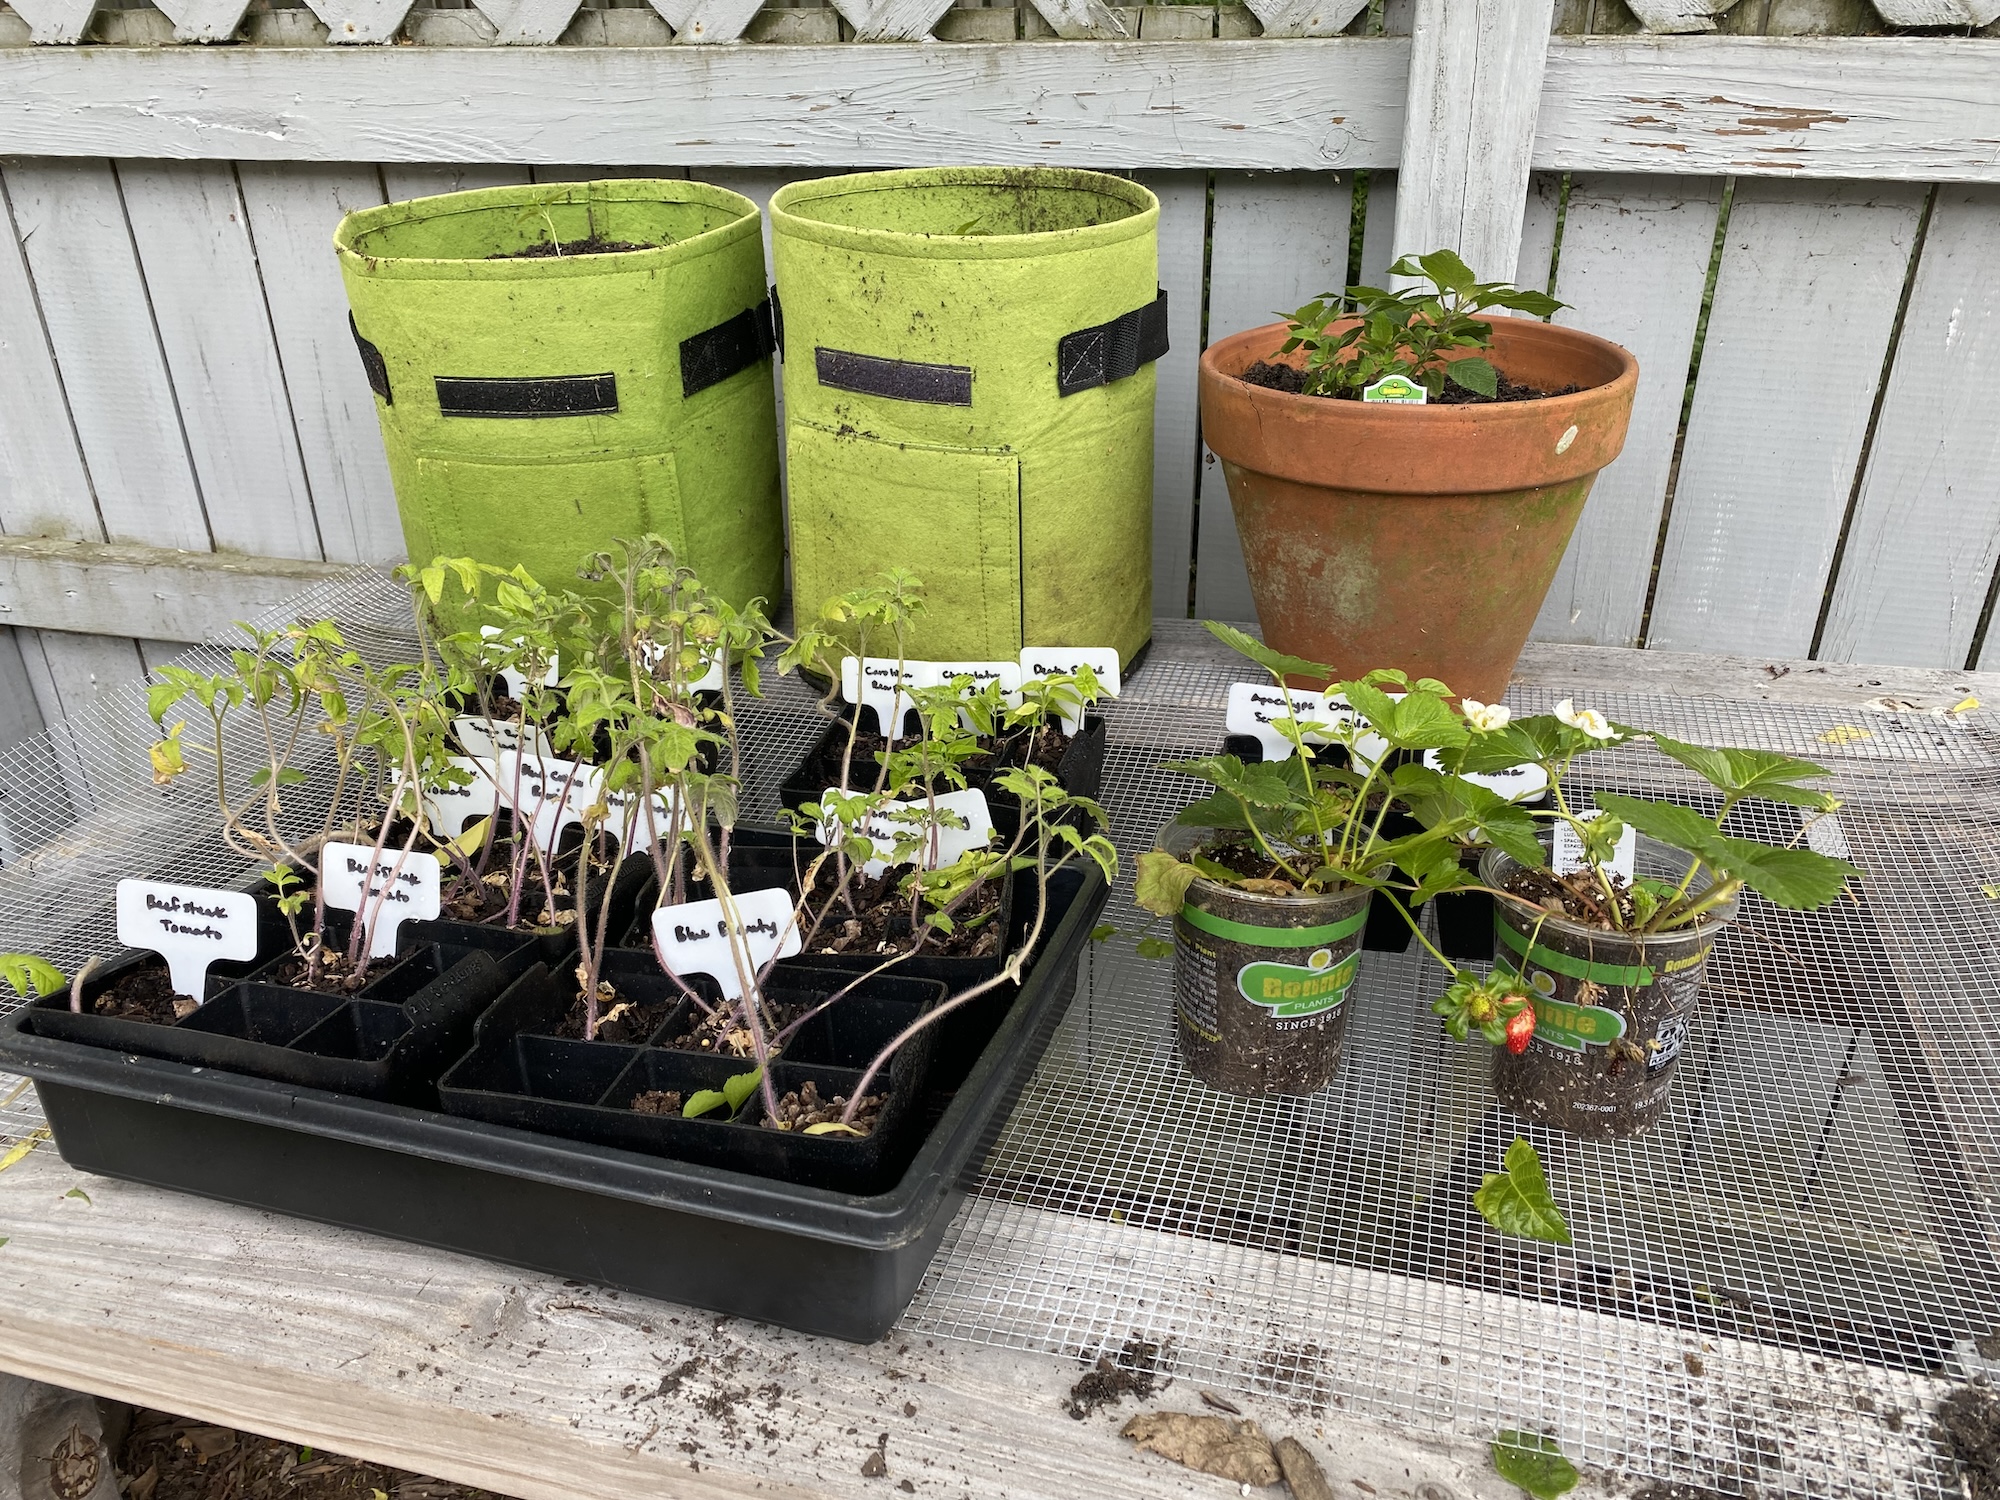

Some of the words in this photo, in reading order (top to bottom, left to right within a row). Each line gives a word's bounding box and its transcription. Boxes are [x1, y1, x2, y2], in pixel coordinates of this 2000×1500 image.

[427, 785, 471, 798] omato
[159, 919, 223, 940] Tomato
[1262, 965, 1353, 998] Bonnie
[1294, 994, 1334, 1010] PLANTS
[1275, 1018, 1317, 1031] SINCE
[1320, 1007, 1342, 1025] 1918
[1535, 1023, 1565, 1041] ANTS
[1572, 1101, 1617, 1113] 202367-0001
